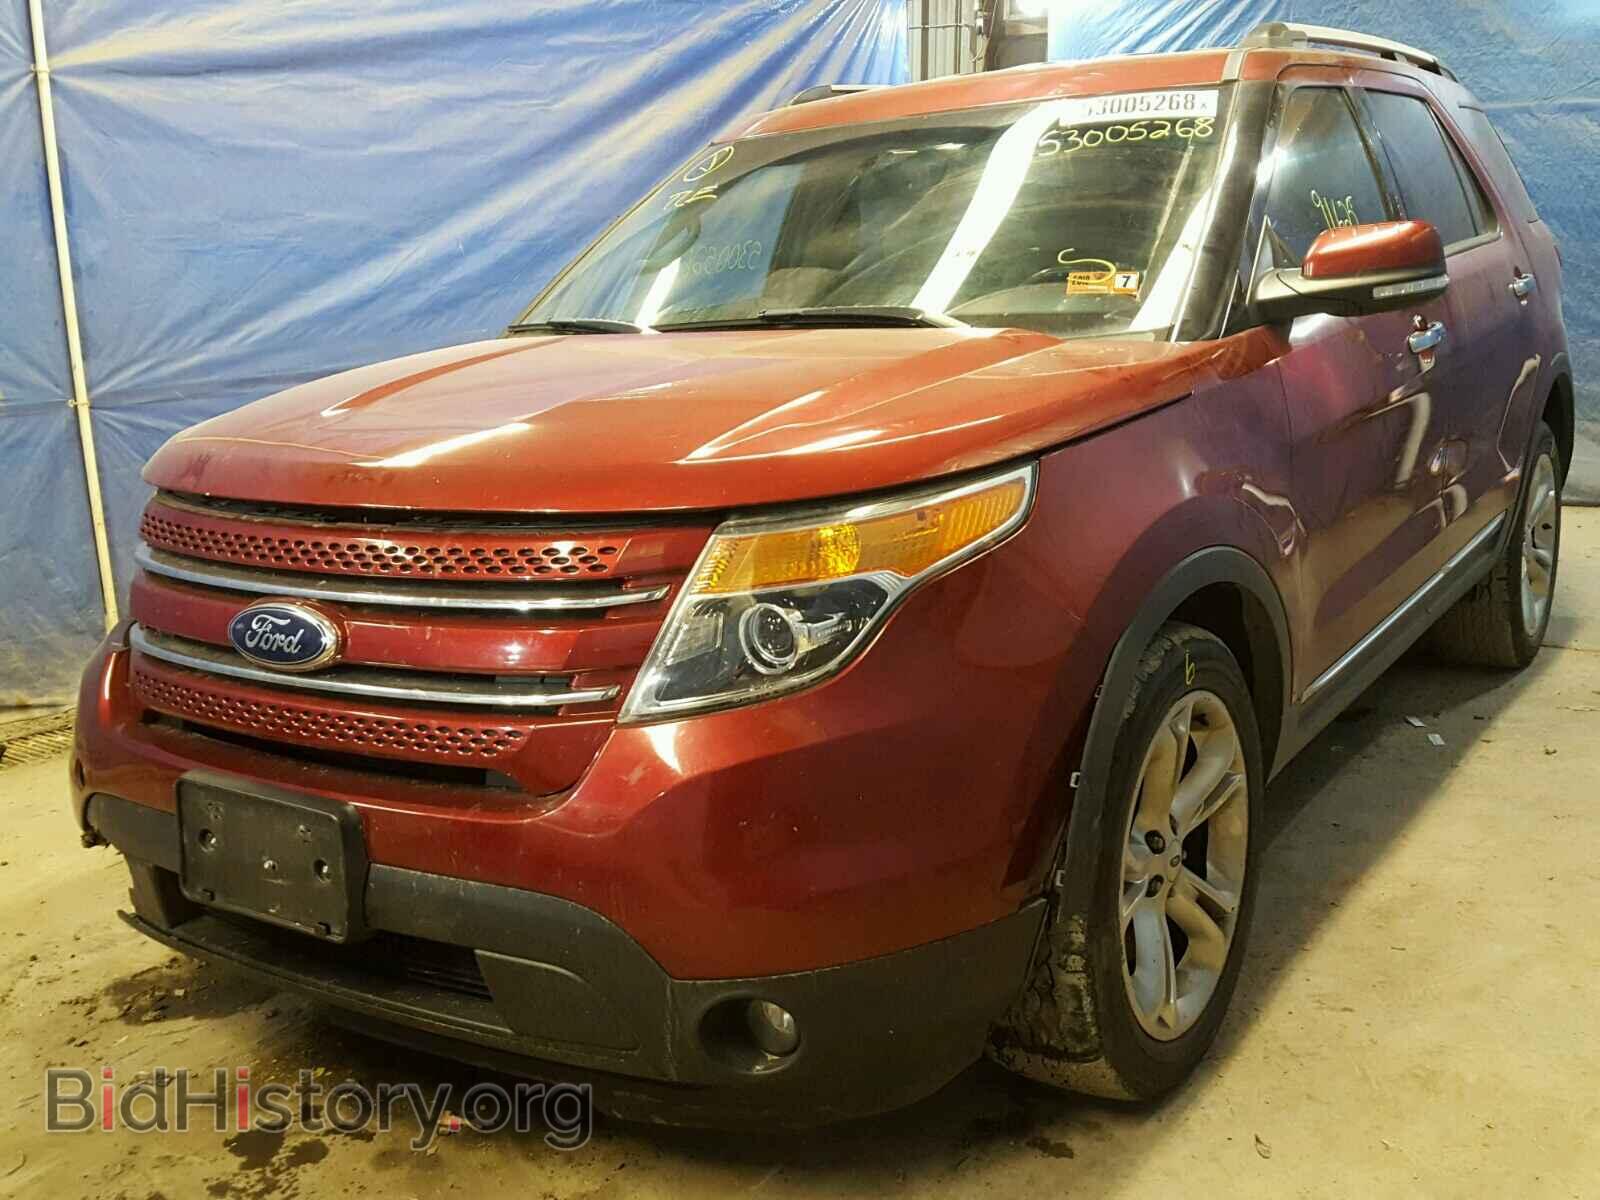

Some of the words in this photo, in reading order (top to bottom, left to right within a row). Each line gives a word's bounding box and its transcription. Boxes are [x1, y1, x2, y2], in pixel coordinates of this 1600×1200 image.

[1039, 117, 1215, 156] 53005268
[1122, 275, 1131, 288] 7
[245, 614, 305, 654] Ford
